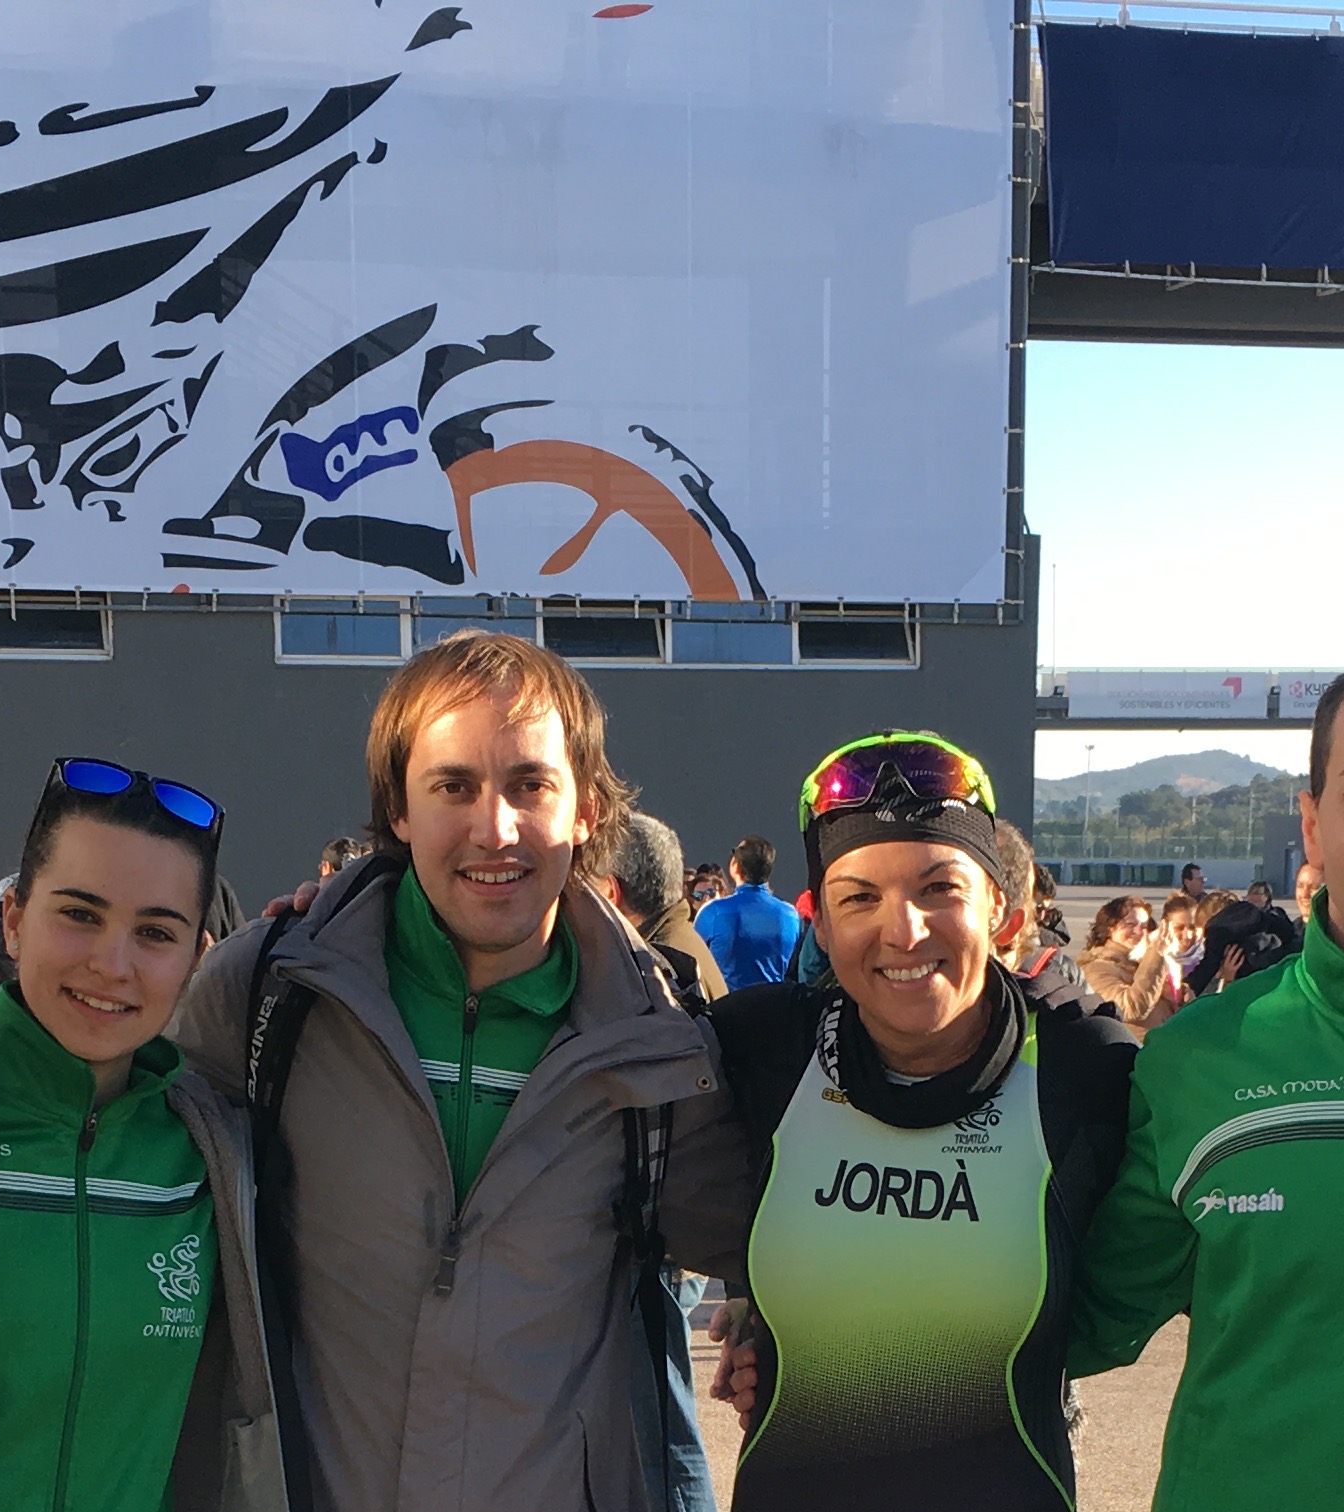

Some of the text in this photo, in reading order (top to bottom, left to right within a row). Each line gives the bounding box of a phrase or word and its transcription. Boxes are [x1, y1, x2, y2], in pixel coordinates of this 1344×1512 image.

[247, 995, 278, 1103] DAKINE
[1234, 1084, 1278, 1101] CASA
[814, 1159, 980, 1222] JORDÀ
[1227, 1187, 1285, 1214] rasán
